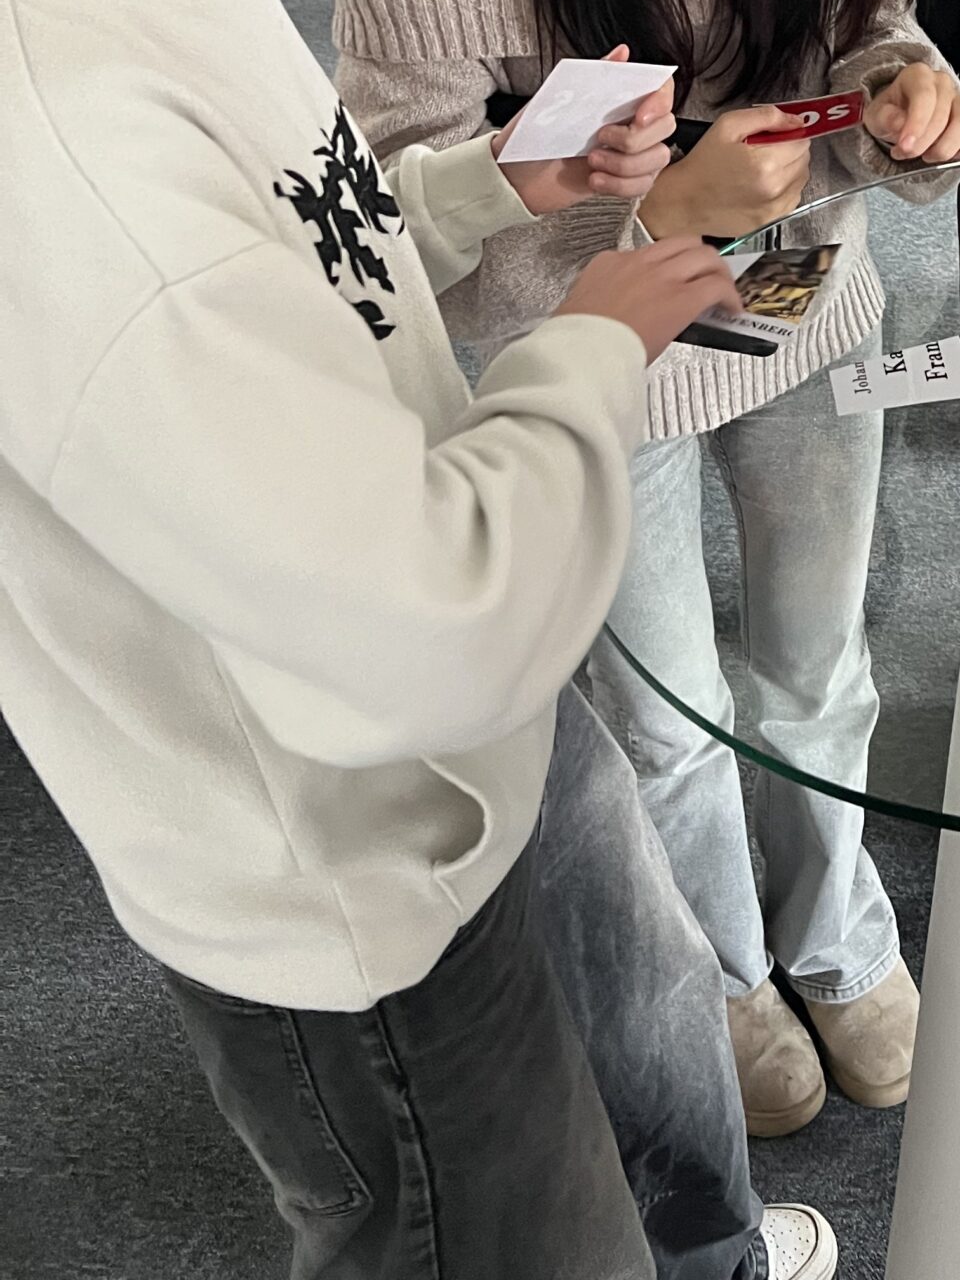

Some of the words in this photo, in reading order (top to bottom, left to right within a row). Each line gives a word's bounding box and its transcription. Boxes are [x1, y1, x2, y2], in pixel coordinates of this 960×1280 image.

[852, 360, 872, 395] Johan
[883, 350, 907, 375] Ka
[924, 342, 948, 382] Fran
